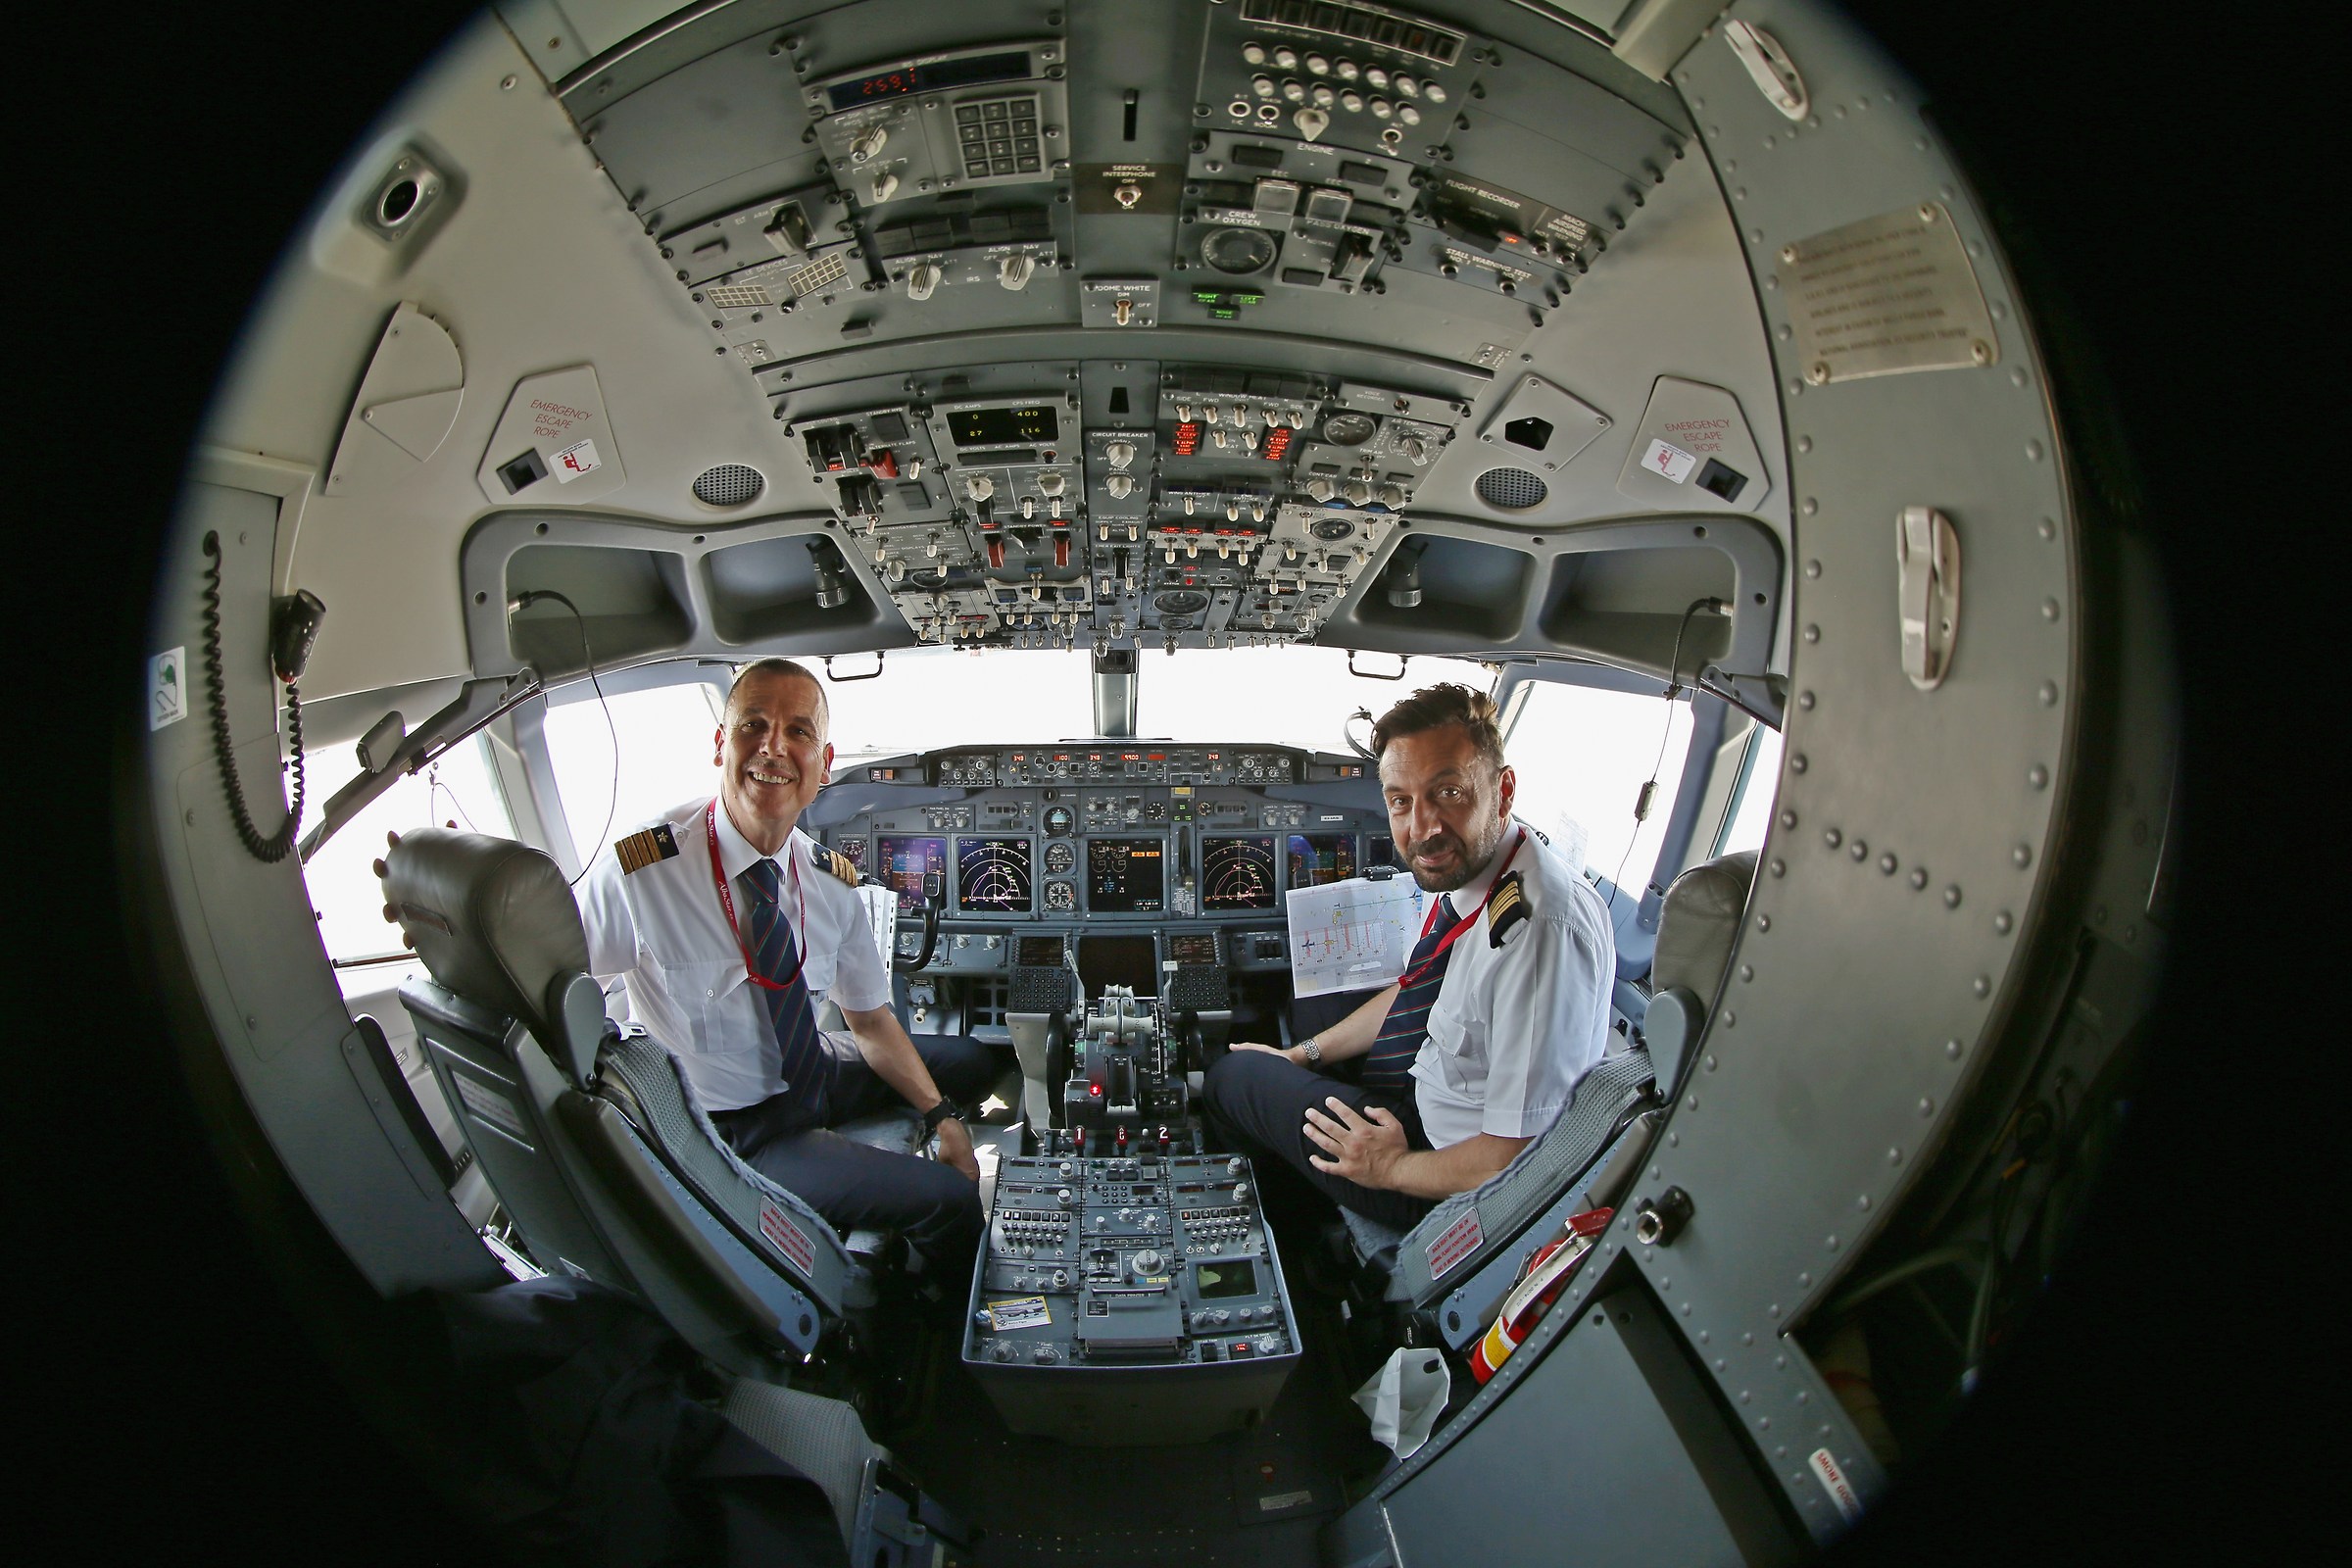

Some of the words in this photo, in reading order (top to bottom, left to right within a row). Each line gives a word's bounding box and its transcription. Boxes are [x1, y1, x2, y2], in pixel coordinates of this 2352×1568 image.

[1297, 143, 1334, 156] ENGINE
[1446, 178, 1478, 193] FLIGHT
[1477, 188, 1521, 210] RECORDER
[1222, 218, 1261, 226] OXYGEN
[1228, 211, 1257, 220] CREW
[1561, 214, 1587, 228] MACH
[1306, 219, 1333, 228] PASS
[1333, 222, 1370, 235] OXYGEN
[1546, 221, 1584, 241] WARNING
[1553, 218, 1587, 235] AIRSPEED
[988, 245, 1011, 254] ALIGN
[1446, 248, 1470, 260] STALL
[1472, 255, 1512, 271] WARNING
[1514, 268, 1533, 278] TEST
[529, 399, 593, 421] EMERGENCY
[534, 414, 573, 429] ESCAPE
[1665, 418, 1731, 432] EMERGENCY
[533, 426, 561, 439] ROPE
[1683, 431, 1724, 442] ESCAPE
[1693, 443, 1722, 452] ROPE
[1076, 1128, 1082, 1140] 1
[1159, 1126, 1169, 1139] 2
